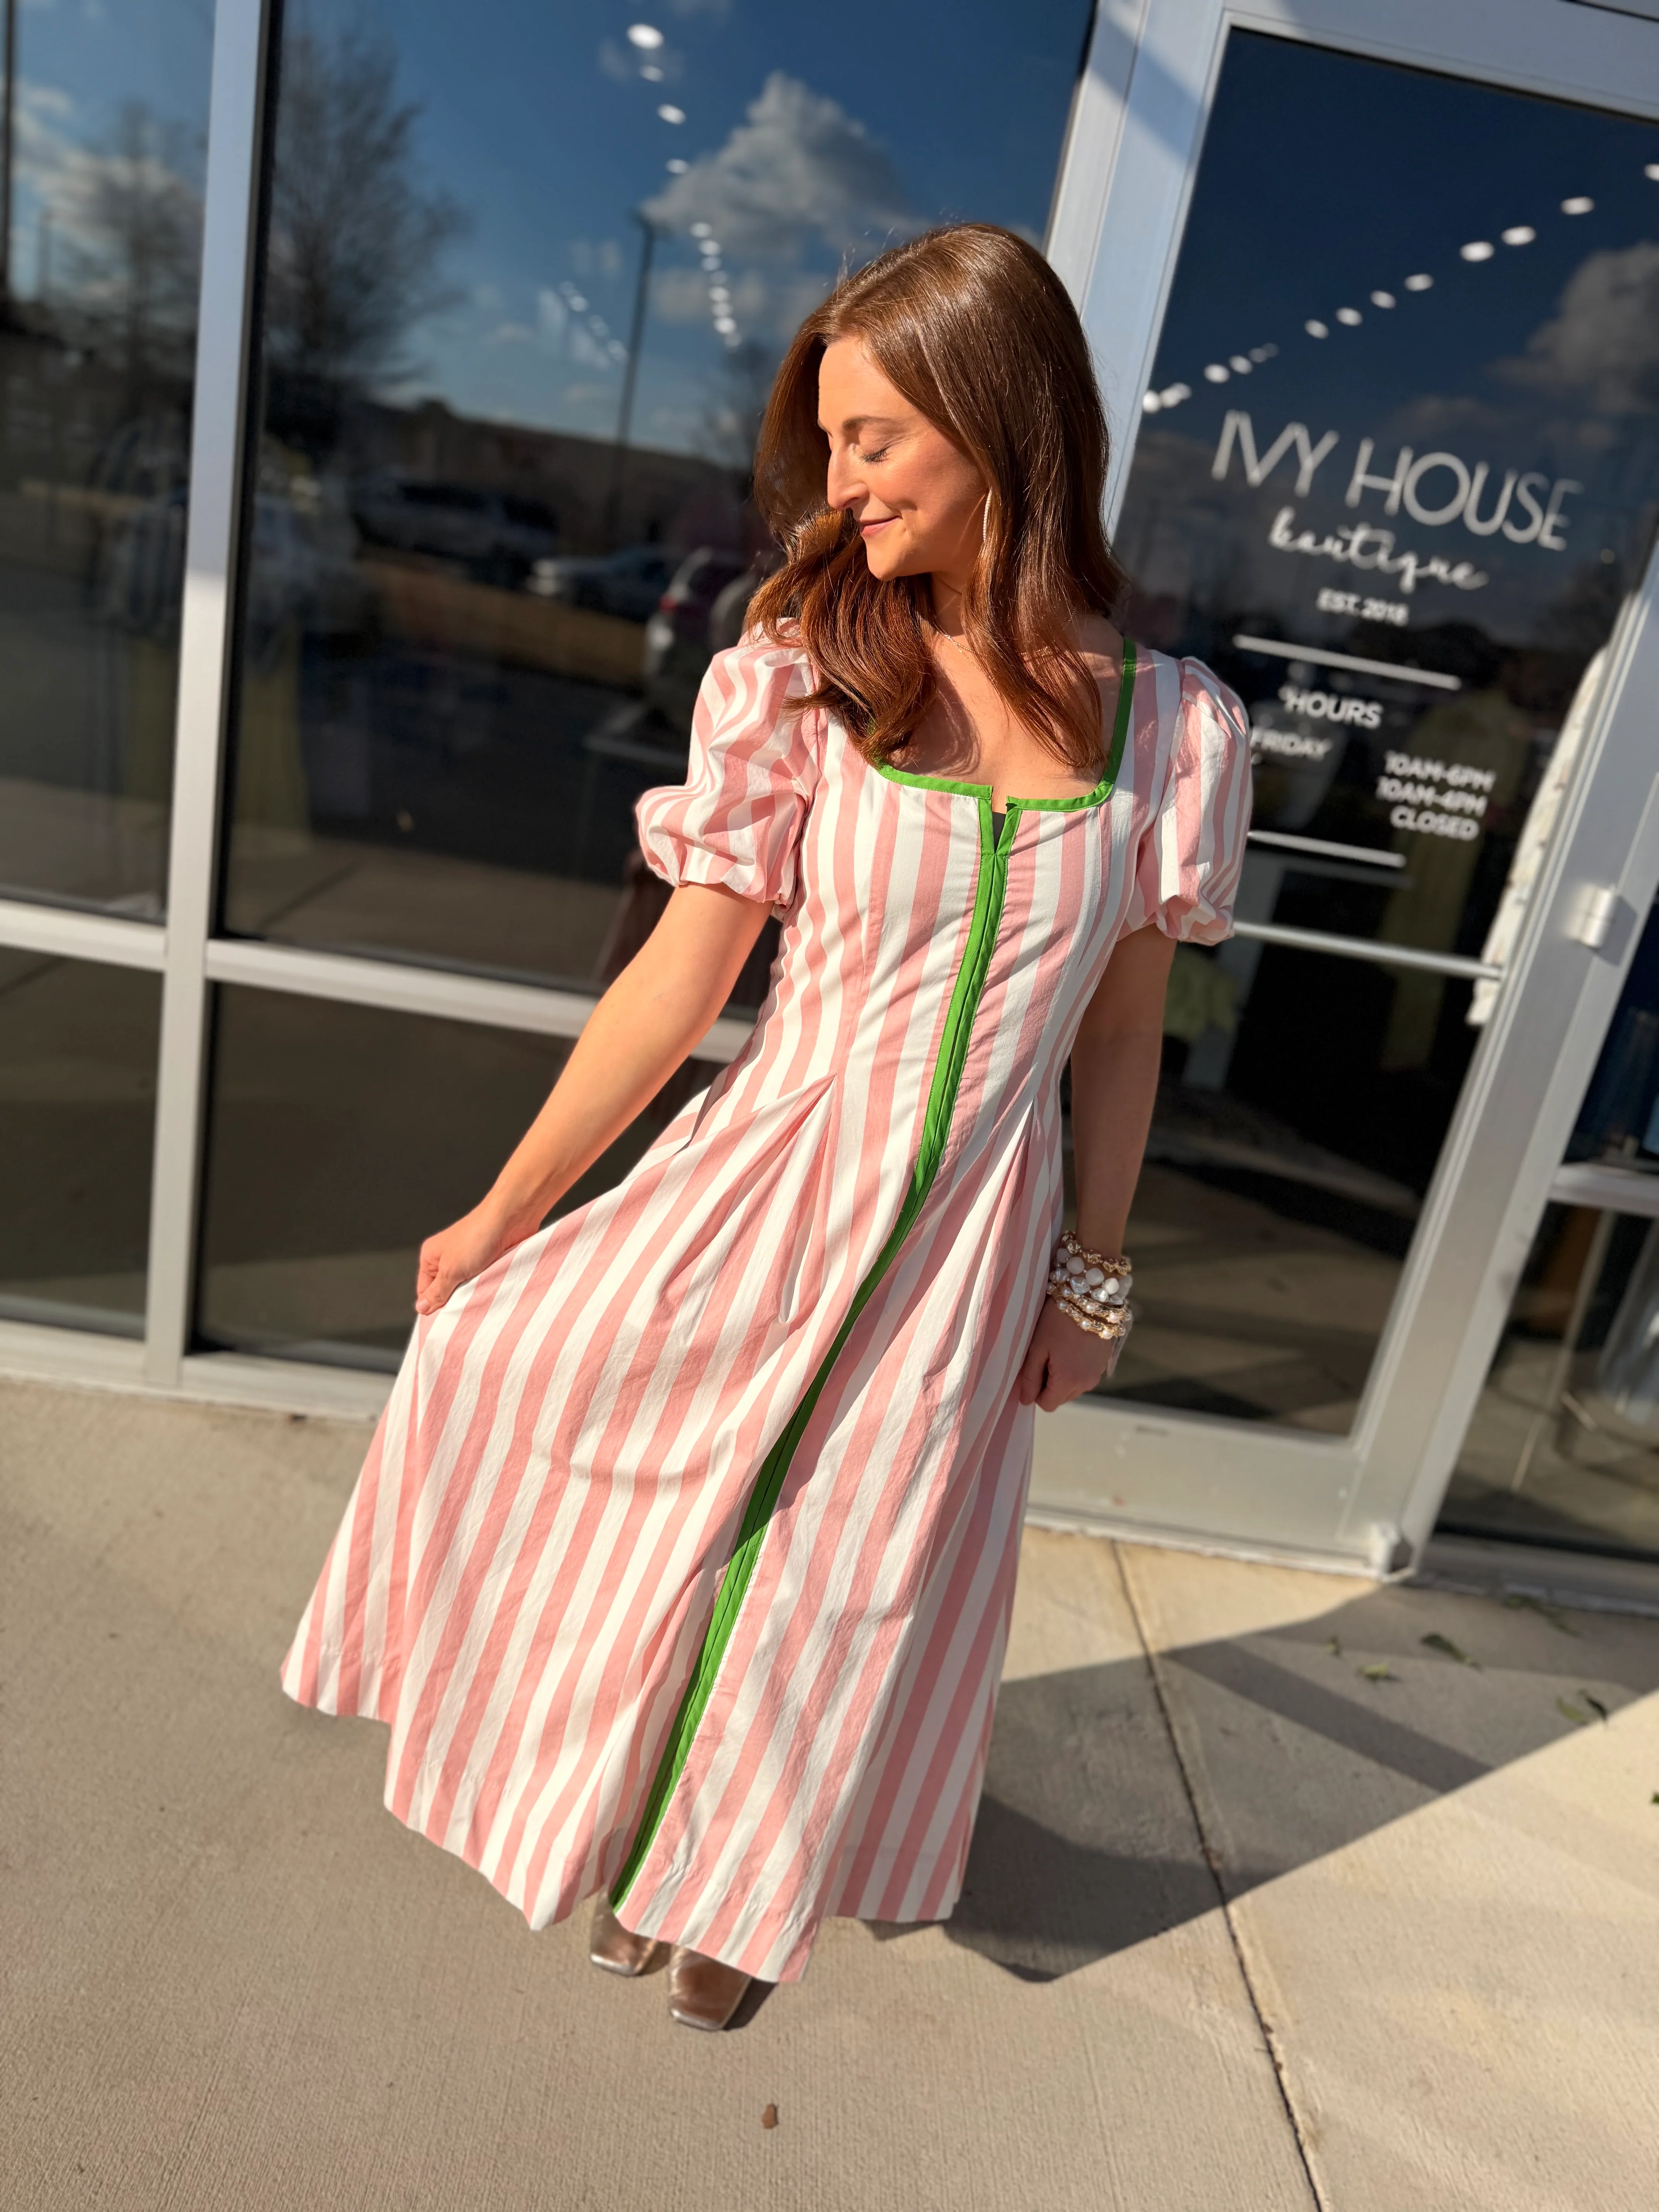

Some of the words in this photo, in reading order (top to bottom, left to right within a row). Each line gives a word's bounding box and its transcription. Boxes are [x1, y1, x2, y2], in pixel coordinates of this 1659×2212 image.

[1211, 409, 1340, 498] IVY
[1345, 437, 1584, 551] HOUSE
[1269, 506, 1489, 594] boutique
[1284, 689, 1383, 730] HOURS
[1384, 750, 1496, 793] 10AM-6PM
[1376, 775, 1487, 817] 10AM-4PM
[1390, 805, 1479, 841] CLOSED
